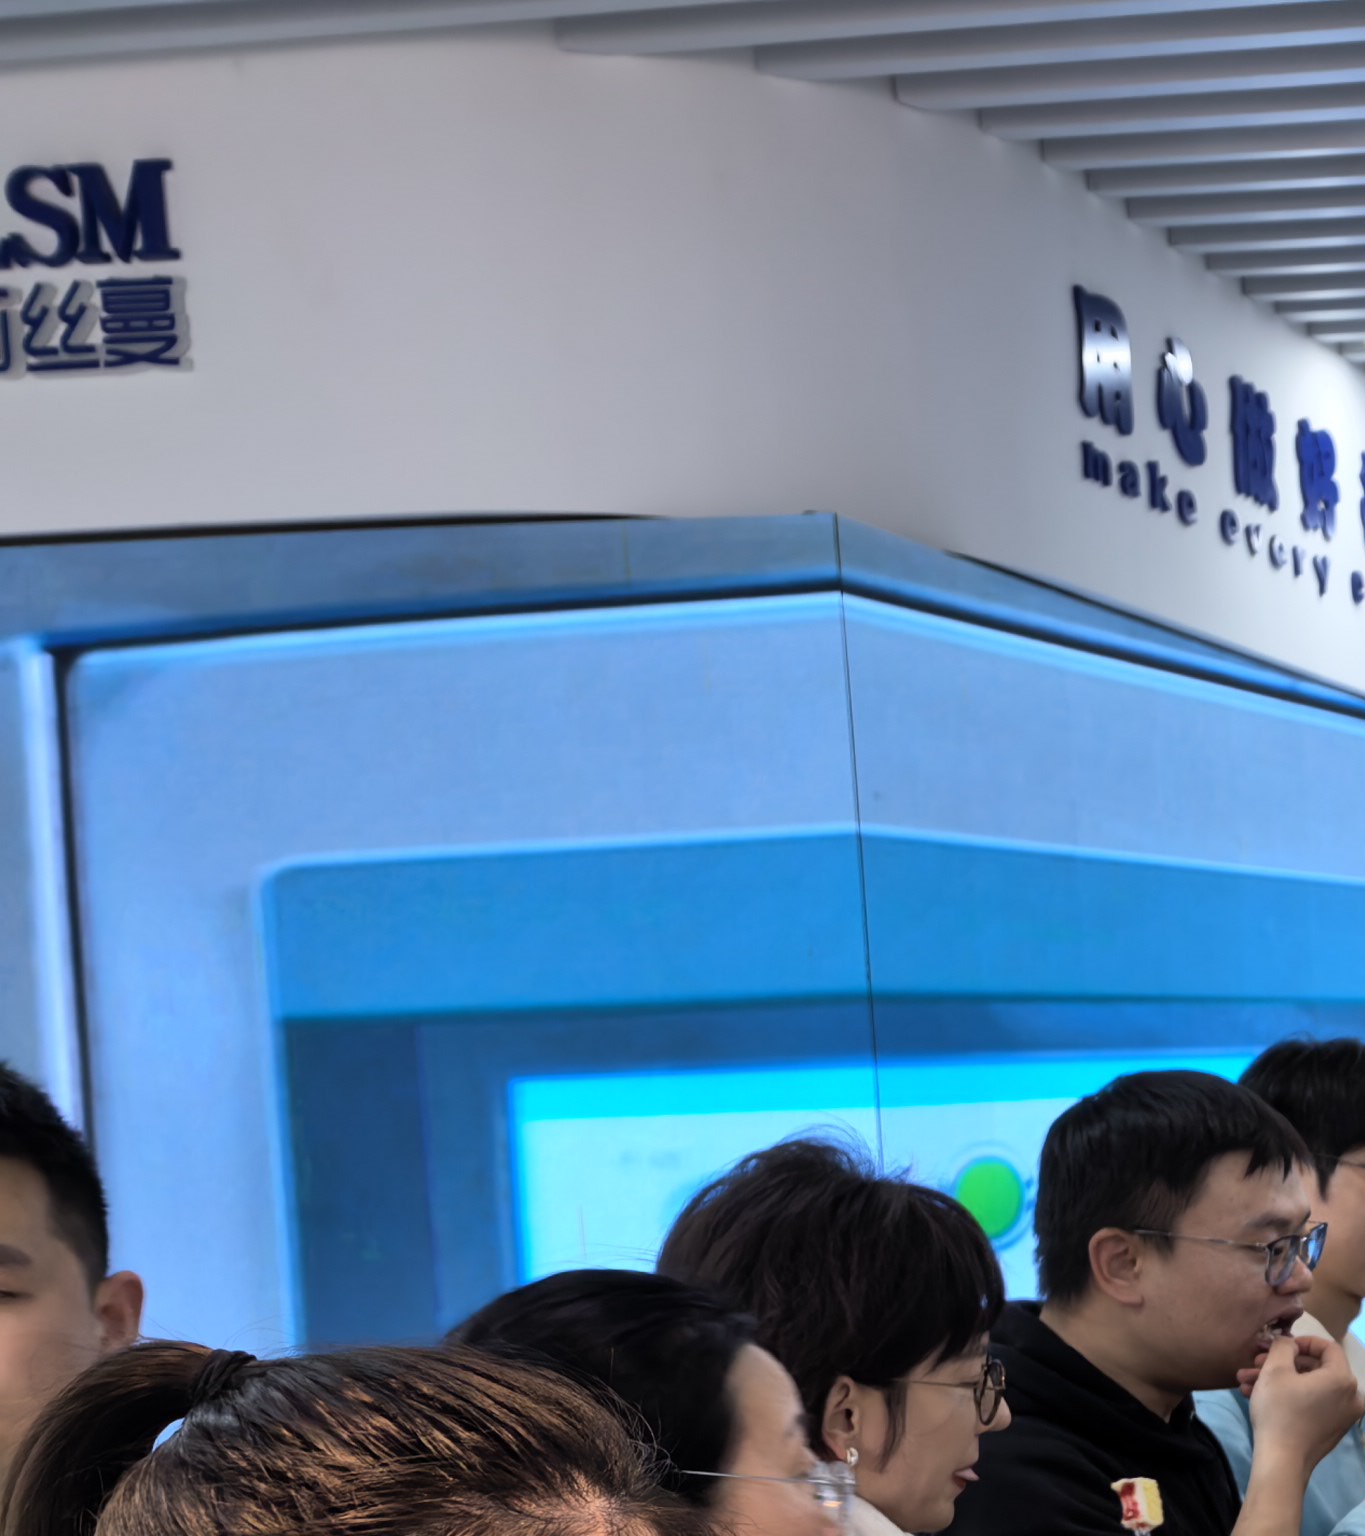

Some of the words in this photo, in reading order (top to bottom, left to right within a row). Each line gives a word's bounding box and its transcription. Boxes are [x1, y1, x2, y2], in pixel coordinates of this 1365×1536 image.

[0, 158, 181, 268] SM
[1081, 441, 1198, 527] make
[1219, 509, 1330, 596] every
